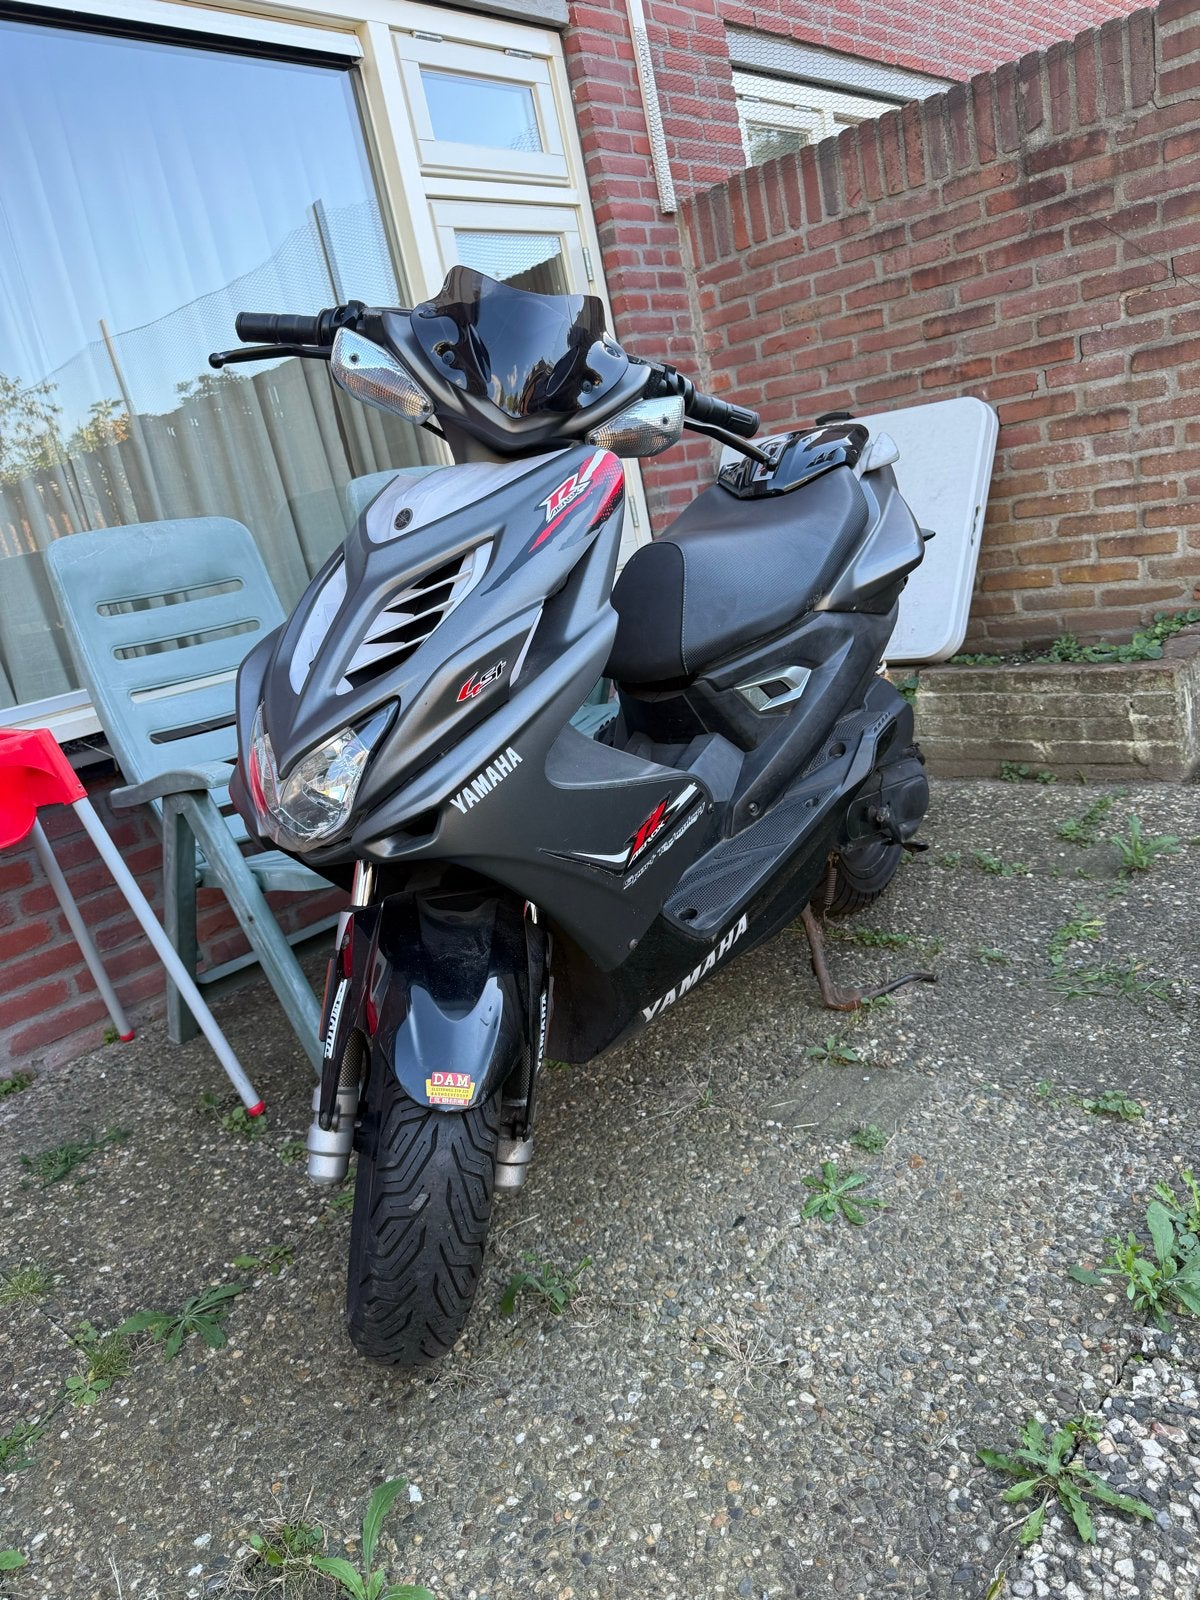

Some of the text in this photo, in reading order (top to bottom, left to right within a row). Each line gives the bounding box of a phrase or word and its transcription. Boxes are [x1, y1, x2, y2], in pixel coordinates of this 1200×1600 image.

[449, 746, 524, 814] YAMAHA
[642, 912, 748, 1023] YAMAHA
[433, 1073, 469, 1087] DAM
